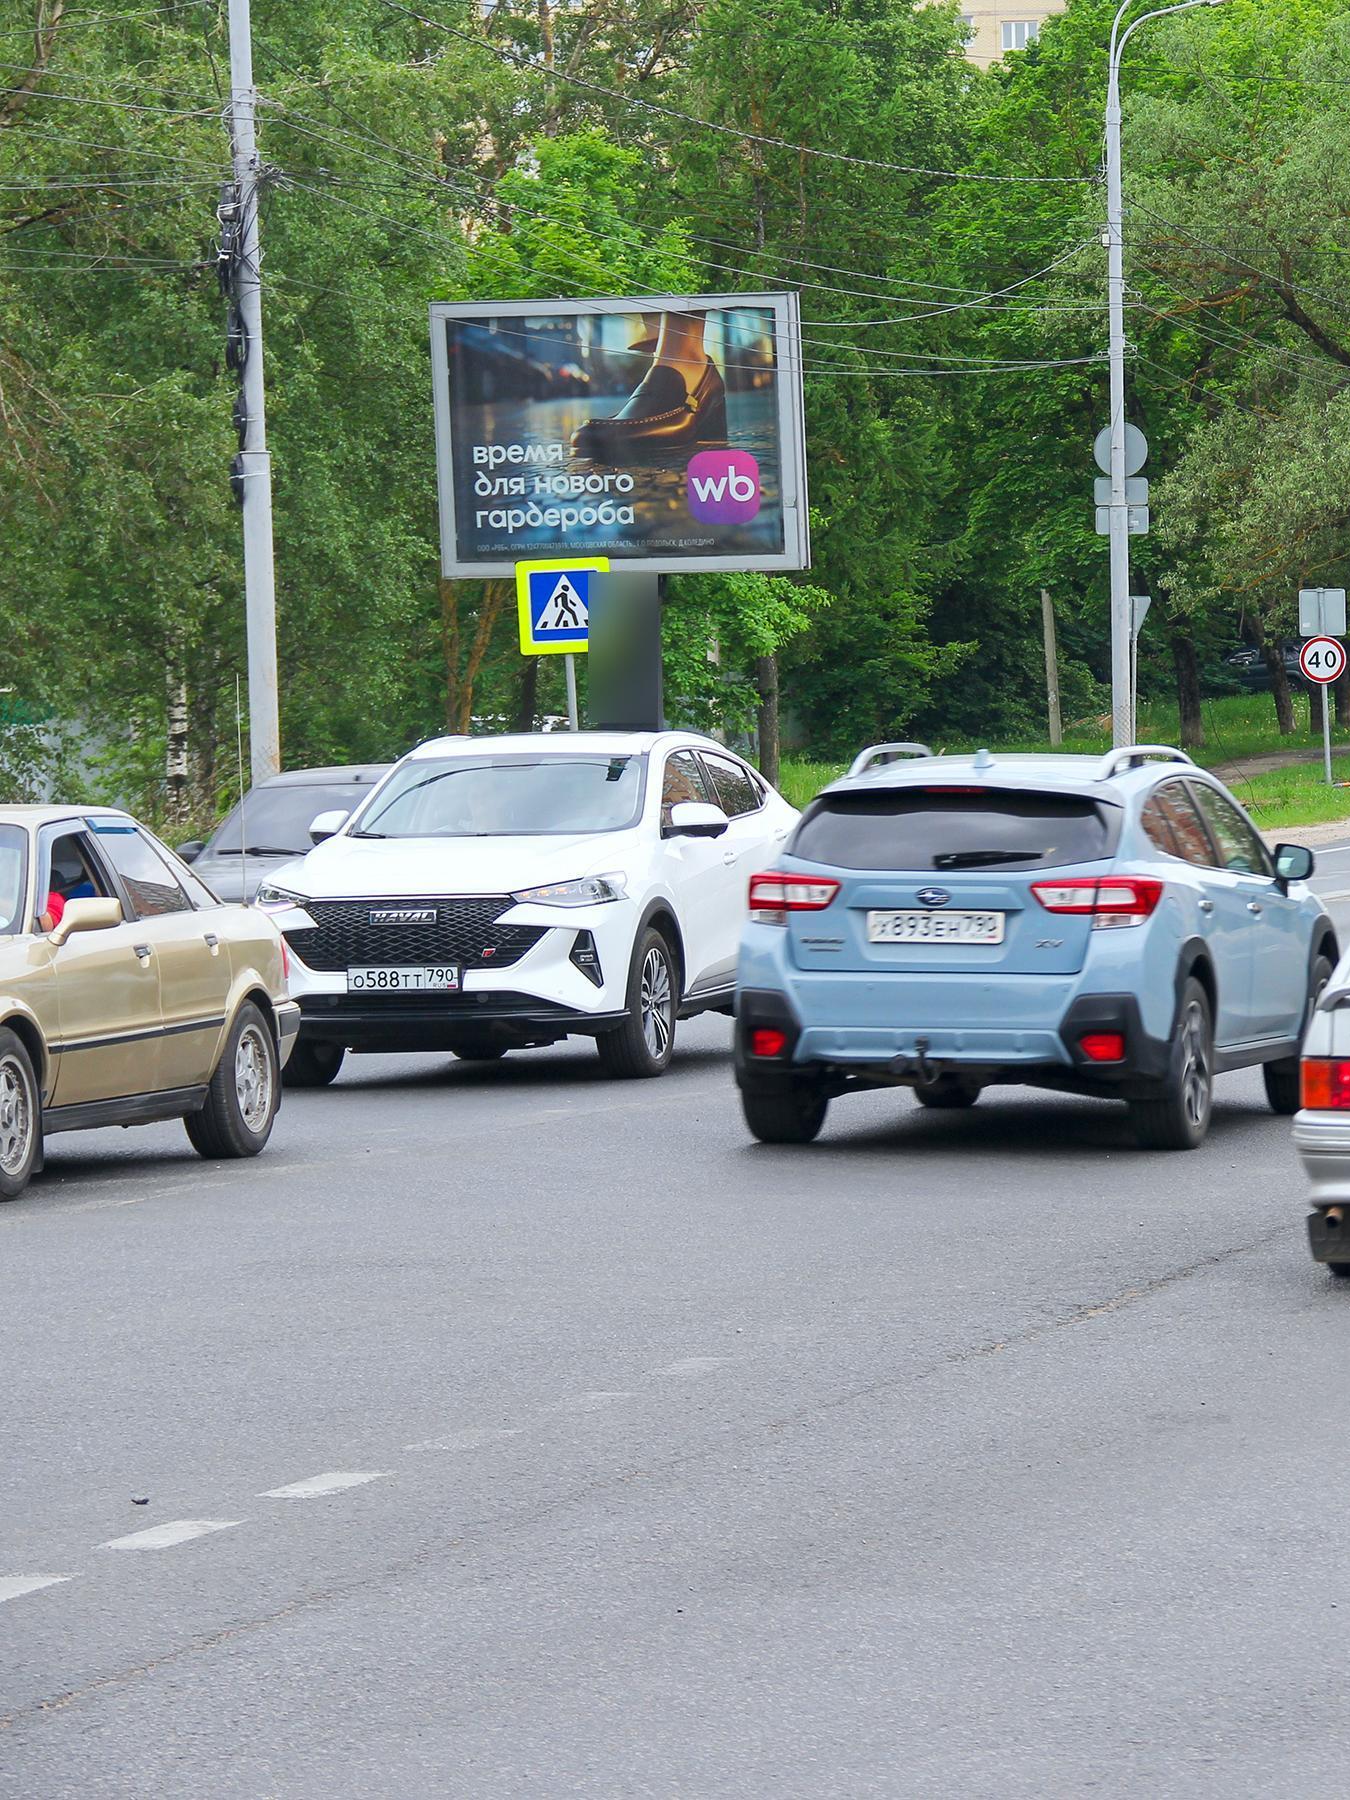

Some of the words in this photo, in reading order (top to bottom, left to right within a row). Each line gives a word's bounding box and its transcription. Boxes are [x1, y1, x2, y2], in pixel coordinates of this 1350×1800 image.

[473, 443, 563, 470] время
[474, 470, 526, 497] для
[534, 472, 635, 496] нового
[691, 465, 755, 503] wb
[476, 499, 635, 533] гардероба
[1307, 650, 1337, 668] 40
[374, 912, 433, 923] HAVAL
